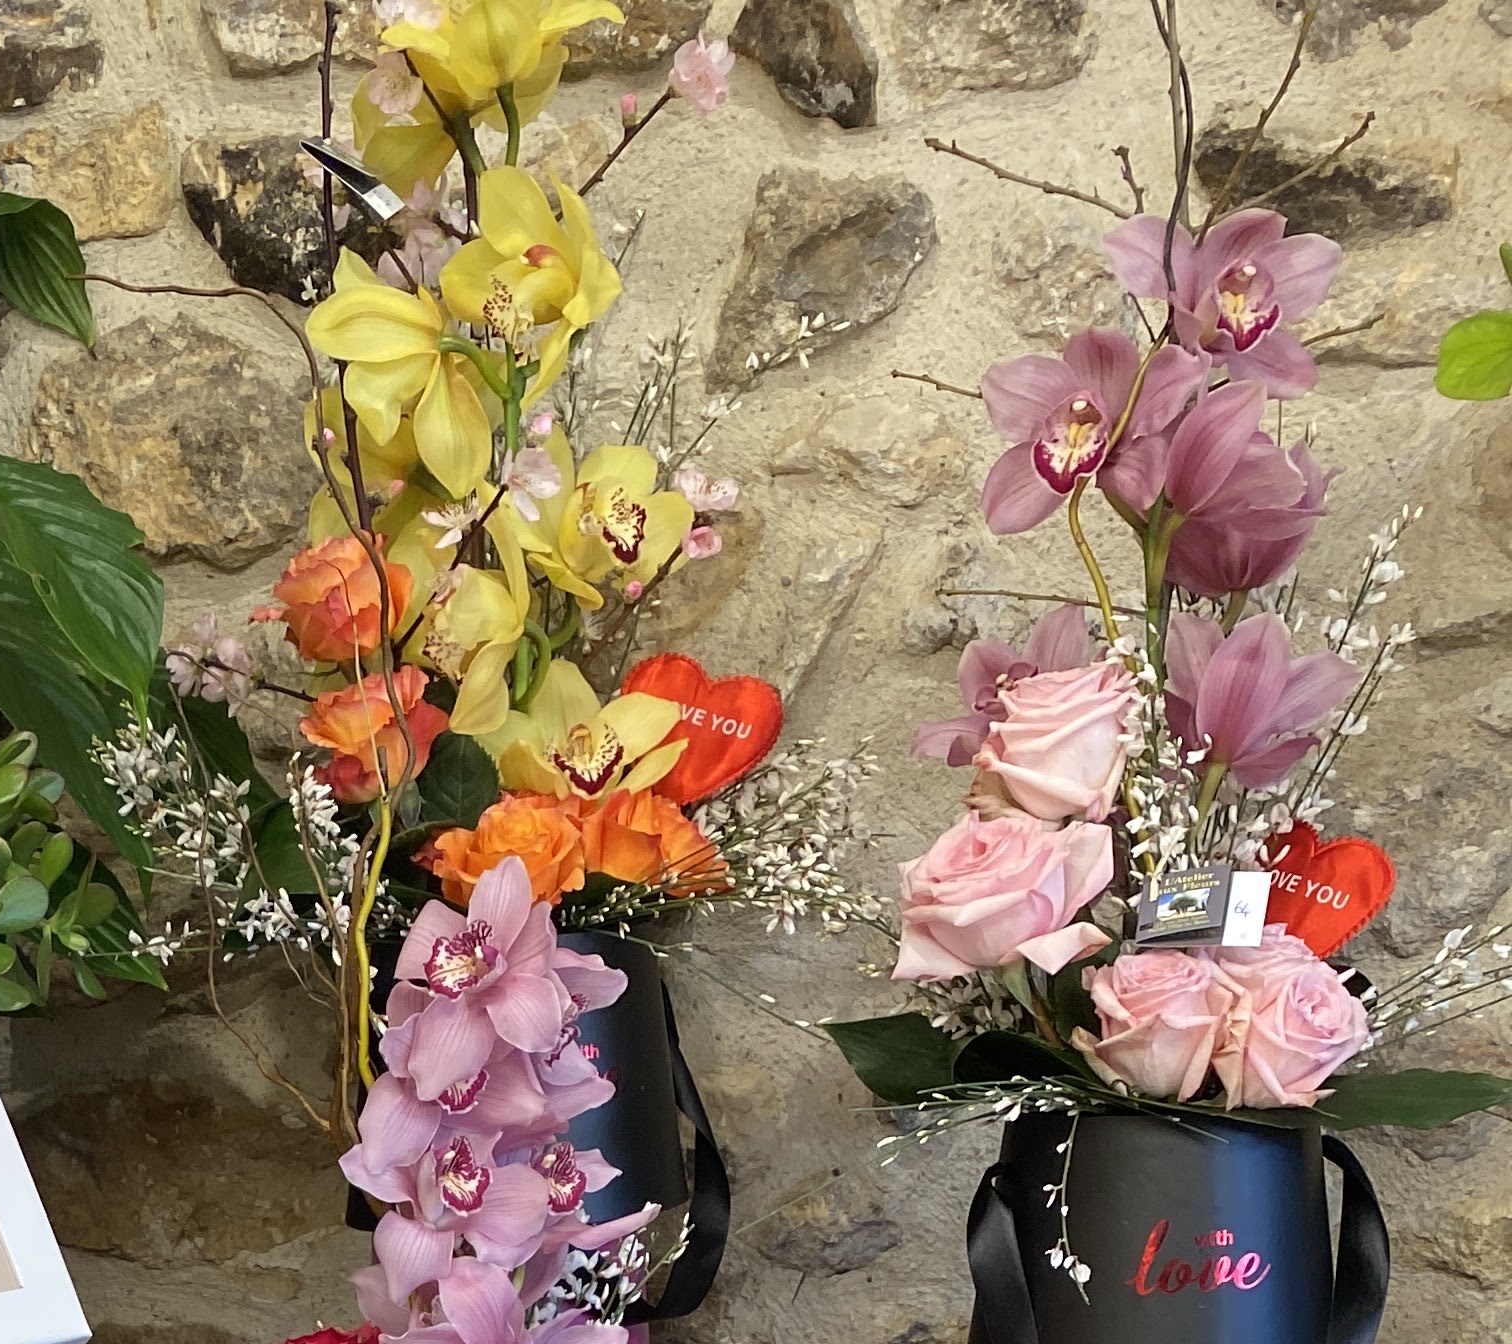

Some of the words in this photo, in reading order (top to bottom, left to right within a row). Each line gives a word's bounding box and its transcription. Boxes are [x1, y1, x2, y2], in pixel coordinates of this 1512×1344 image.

[710, 713, 752, 739] YOU
[1182, 879, 1221, 892] Fleurs
[1270, 869, 1302, 893] OVE
[1304, 880, 1351, 910] YOU
[1194, 1228, 1235, 1247] with
[1123, 1218, 1272, 1296] love
